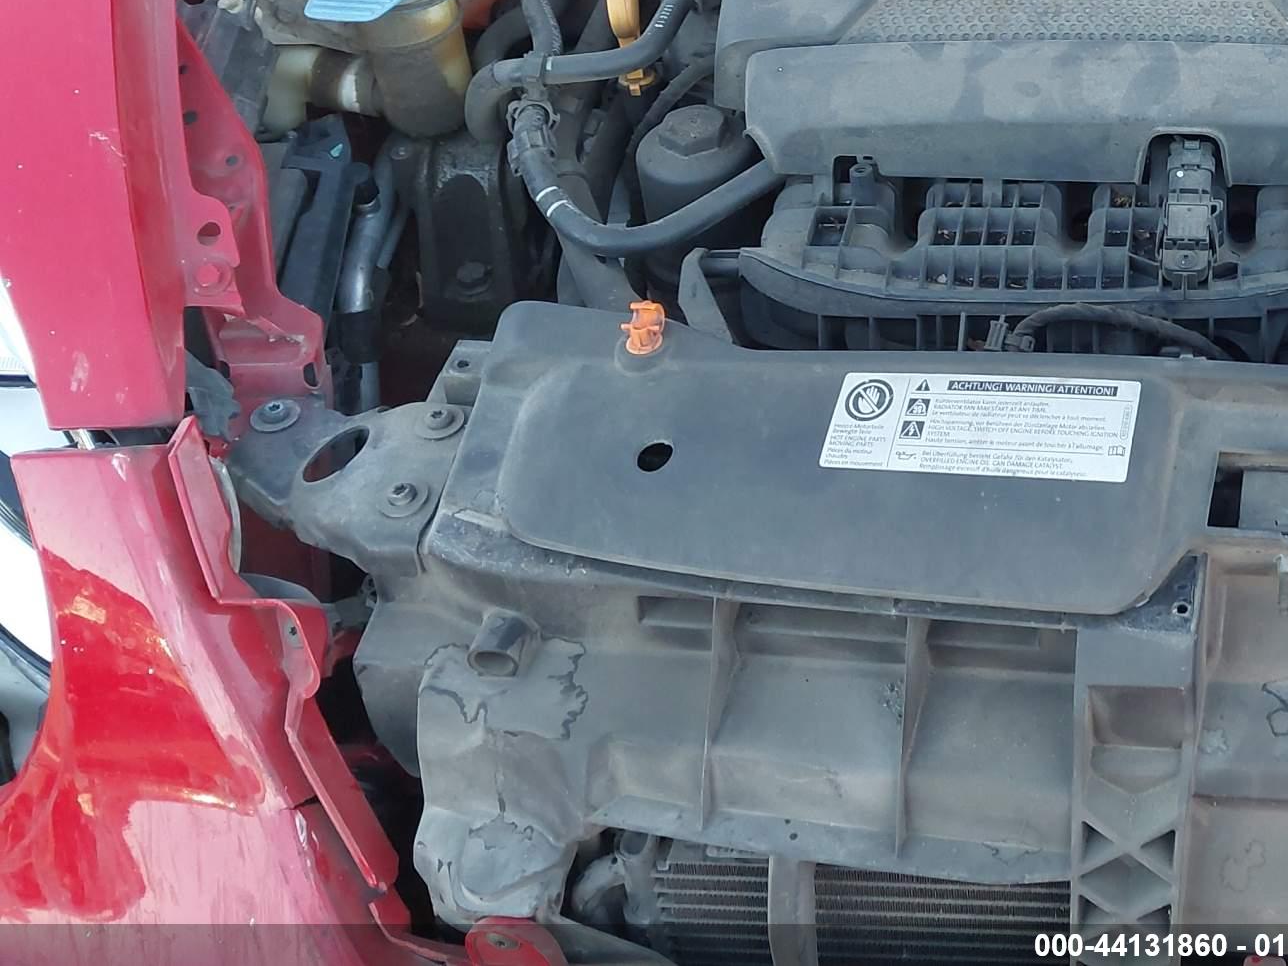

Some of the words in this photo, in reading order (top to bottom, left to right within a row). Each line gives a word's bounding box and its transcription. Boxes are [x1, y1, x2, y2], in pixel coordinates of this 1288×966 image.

[951, 381, 1003, 391] ACHTUNG!
[1005, 382, 1056, 394] WARNING!
[1056, 384, 1115, 396] ATTENTION!
